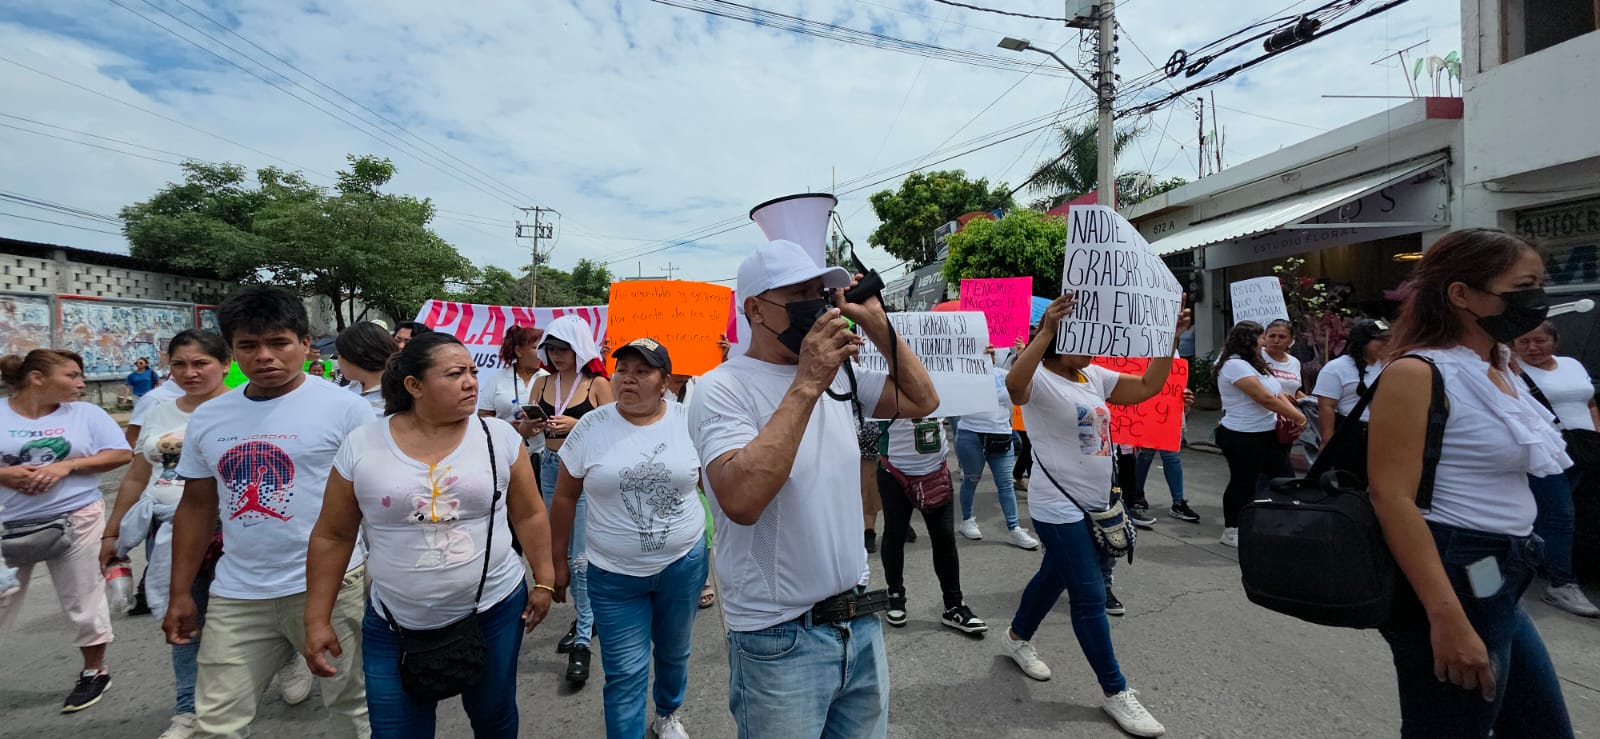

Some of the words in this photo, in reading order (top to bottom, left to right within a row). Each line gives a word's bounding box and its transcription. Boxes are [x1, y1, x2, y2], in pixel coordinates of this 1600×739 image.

[1072, 210, 1127, 244] NADIE
[1153, 223, 1167, 235] 672
[1305, 228, 1358, 243] FLORAL
[1067, 248, 1143, 287] GRABAR
[1113, 291, 1171, 326] EVIDENCIA
[1057, 321, 1131, 357] USTEDES
[8, 428, 65, 438] TOXICO
